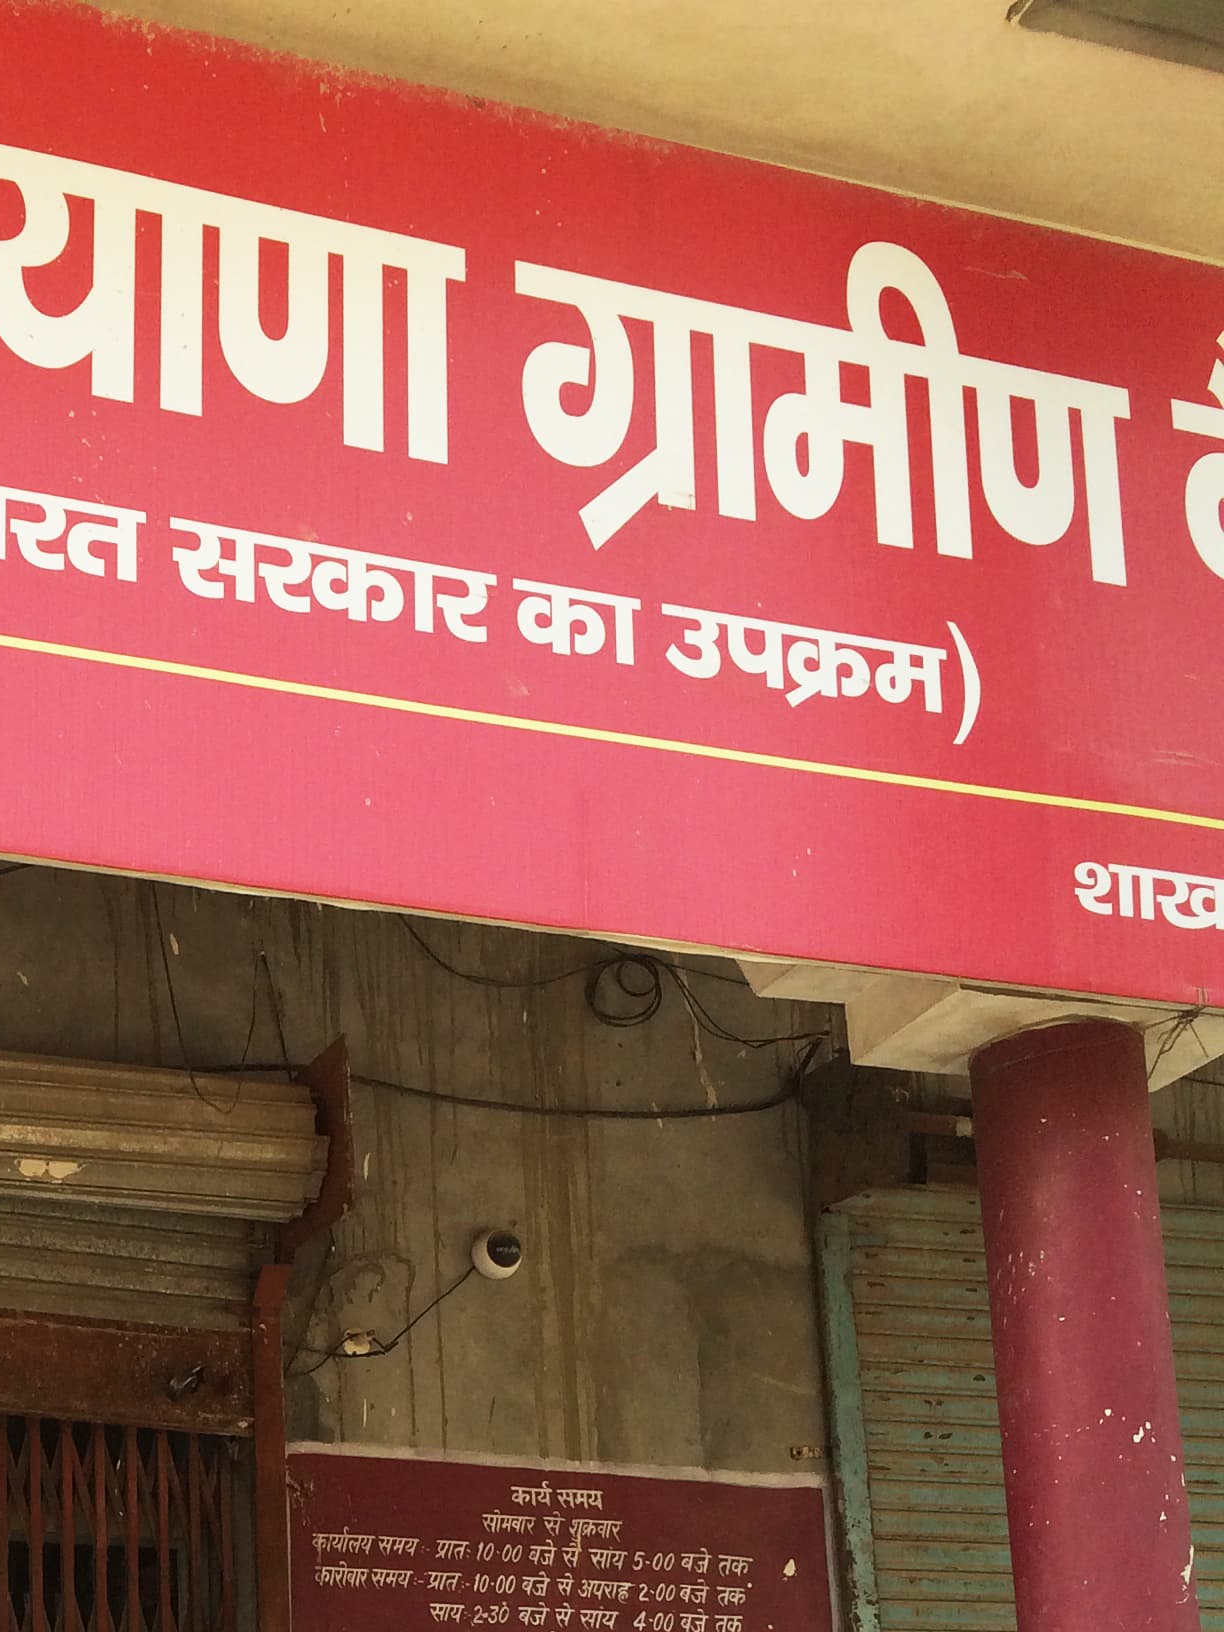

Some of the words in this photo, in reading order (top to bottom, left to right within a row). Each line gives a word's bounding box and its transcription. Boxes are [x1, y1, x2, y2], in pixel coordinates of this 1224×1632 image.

[514, 241, 1131, 587] ग्रामीण
[170, 516, 497, 643] सरकार
[512, 579, 641, 667] का
[661, 604, 982, 746] उपक्रम)
[510, 1481, 553, 1507] कार्य
[557, 1489, 604, 1511] समय
[482, 1509, 536, 1535] सोमवार
[543, 1511, 566, 1537] से
[569, 1518, 624, 1543] शुक्रवार
[312, 1526, 376, 1555] कार्यालय
[528, 1539, 558, 1567] बजे
[562, 1543, 582, 1568] से
[632, 1551, 675, 1571] 5-00
[681, 1547, 713, 1574] बजे
[718, 1554, 754, 1577] तक
[314, 1561, 370, 1590] कारोबार
[521, 1571, 551, 1597] बजे
[556, 1573, 575, 1597] से
[679, 1579, 711, 1604] बजे
[716, 1586, 747, 1607] तक
[518, 1602, 551, 1627] बजे
[554, 1603, 576, 1629] से
[632, 1610, 675, 1632] 4-00
